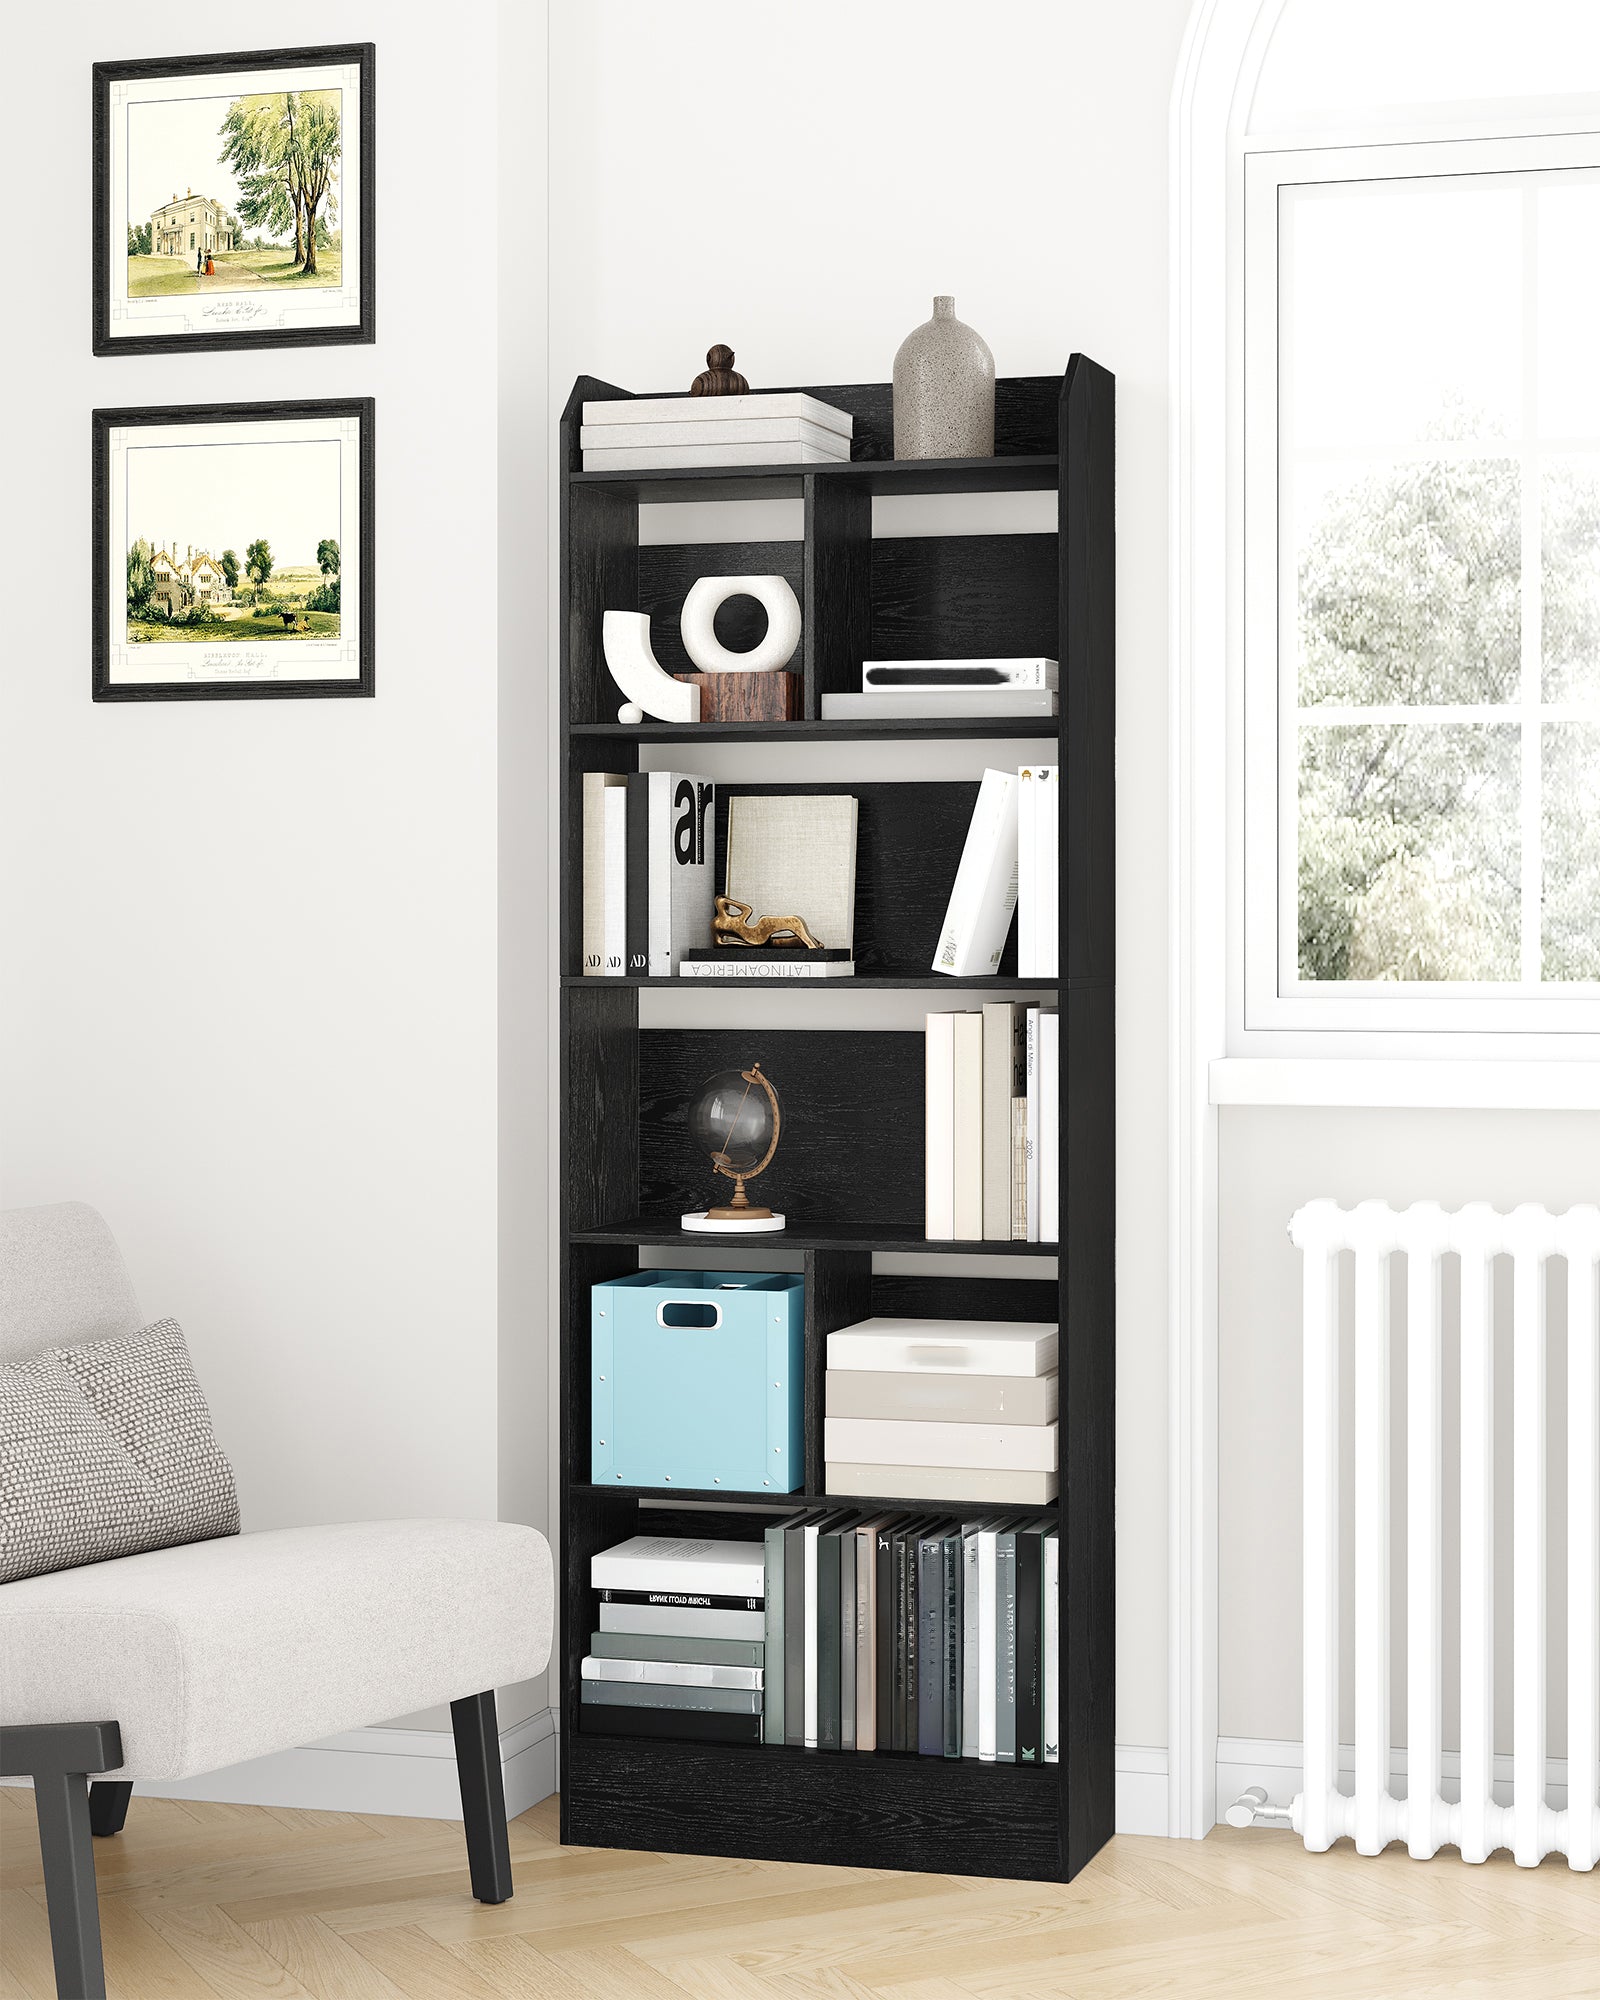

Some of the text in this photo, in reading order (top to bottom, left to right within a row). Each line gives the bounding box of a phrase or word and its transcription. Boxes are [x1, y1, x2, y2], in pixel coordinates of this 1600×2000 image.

[585, 954, 601, 967] AD
[606, 956, 621, 968] AD
[630, 954, 646, 968] AD
[691, 964, 811, 977] LATINOAMERICA
